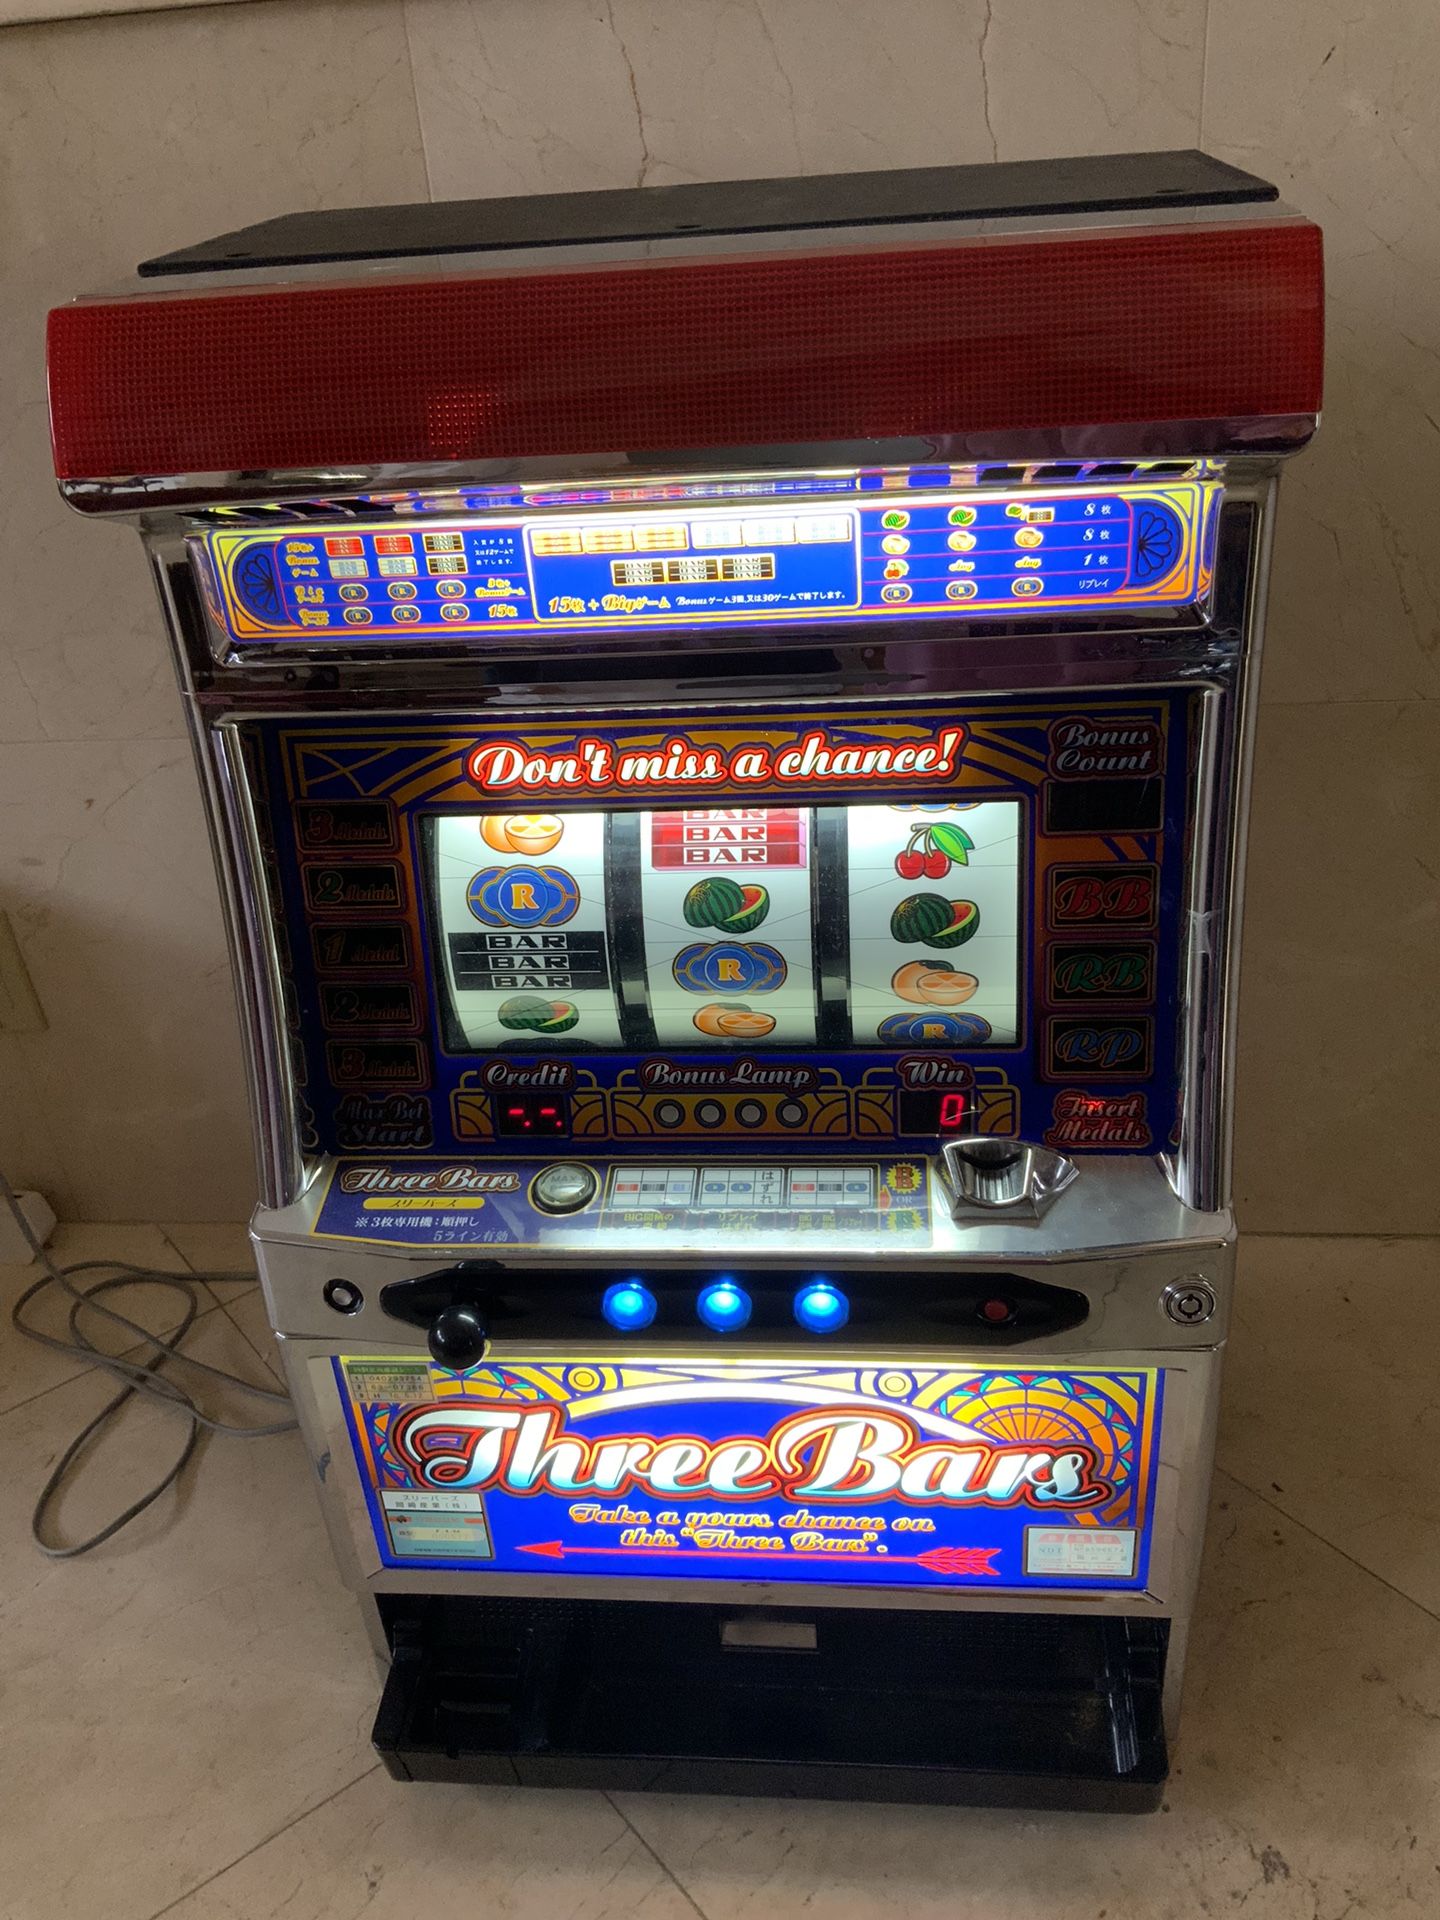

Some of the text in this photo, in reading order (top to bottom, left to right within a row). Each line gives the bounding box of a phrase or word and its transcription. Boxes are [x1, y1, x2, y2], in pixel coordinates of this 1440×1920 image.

[1079, 578, 1109, 589] リプレイ
[1056, 723, 1150, 748] Bonus
[473, 732, 965, 786] Don't miss a chance!
[1056, 749, 1152, 772] Count
[686, 826, 765, 841] BAR
[686, 848, 766, 863] BAR
[314, 870, 344, 904] 2
[511, 883, 540, 910] R
[1054, 875, 1151, 919] BB
[487, 935, 566, 949] BAR
[490, 955, 569, 970] BAR
[717, 958, 747, 982] R
[1054, 953, 1150, 993] RB
[494, 975, 571, 988] BAR
[922, 1023, 946, 1041] R
[1055, 1028, 1144, 1068] RP
[486, 1064, 570, 1087] Credit
[645, 1061, 813, 1088] Bonus Lamp
[904, 1061, 965, 1084] Win
[342, 1100, 424, 1120] Max Bet
[939, 1093, 965, 1127] 0
[1060, 1096, 1139, 1117] Insert
[345, 1122, 425, 1143] Start
[1051, 1119, 1142, 1142] Medals
[345, 1167, 516, 1190] Three Bars
[434, 1230, 509, 1243] 5ライン有効
[404, 1408, 1099, 1500] Three Bars
[569, 1503, 936, 1532] Take a yours chance on
[620, 1527, 680, 1547] this
